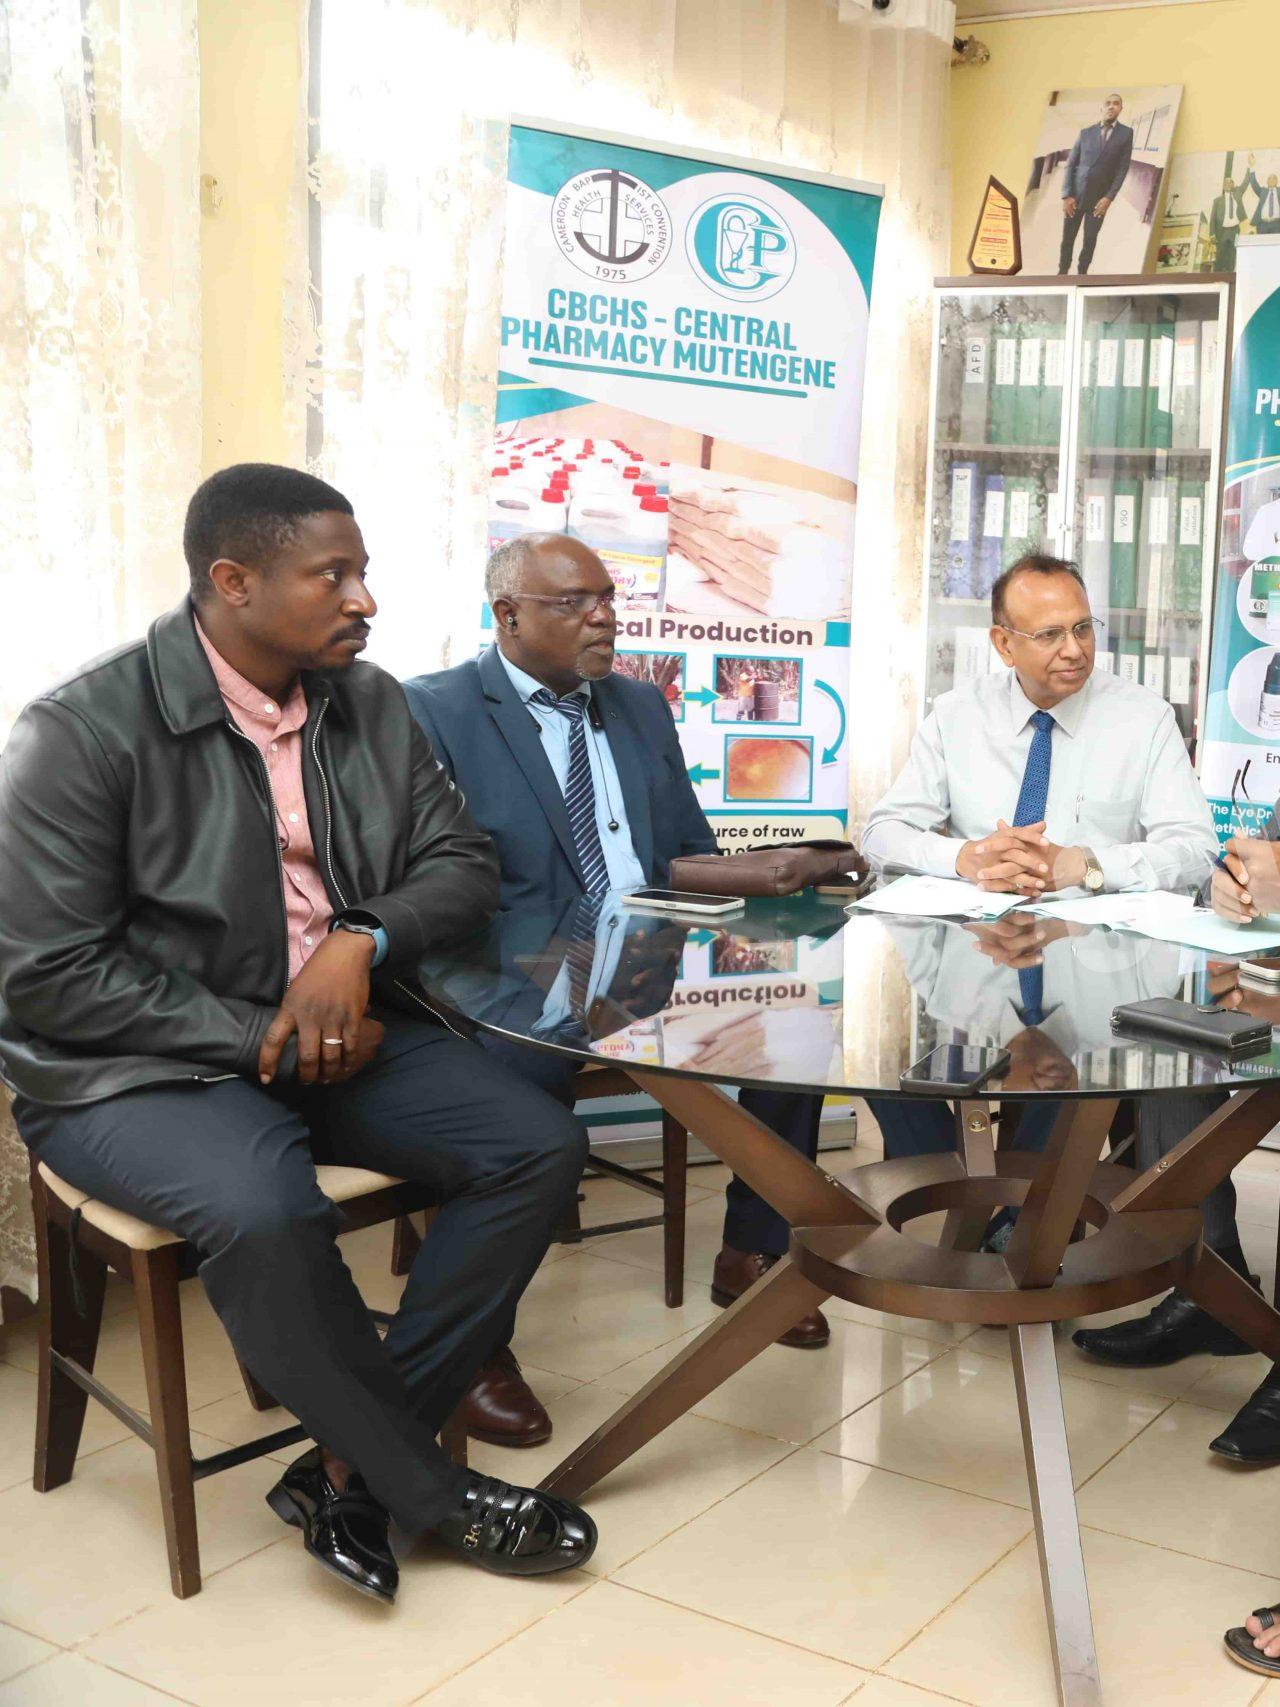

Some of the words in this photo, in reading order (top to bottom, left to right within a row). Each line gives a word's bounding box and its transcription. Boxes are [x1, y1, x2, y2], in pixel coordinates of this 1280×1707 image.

[572, 190, 601, 217] HEALTH
[624, 193, 654, 236] SERVICES
[558, 195, 575, 253] CAMEROON
[647, 203, 666, 266] CONVENTION
[594, 265, 627, 280] 1975
[547, 287, 648, 330] CBCHS
[674, 306, 797, 351] CENTRAL
[501, 316, 667, 366] PHARMACY
[673, 342, 837, 389] MUTENGENE
[1120, 509, 1128, 528] VSO
[615, 618, 650, 637] cal
[660, 620, 813, 646] Production
[1208, 803, 1228, 815] The
[1257, 808, 1273, 819] Dr
[713, 826, 748, 838] urce
[752, 824, 769, 838] of
[772, 827, 805, 838] raw
